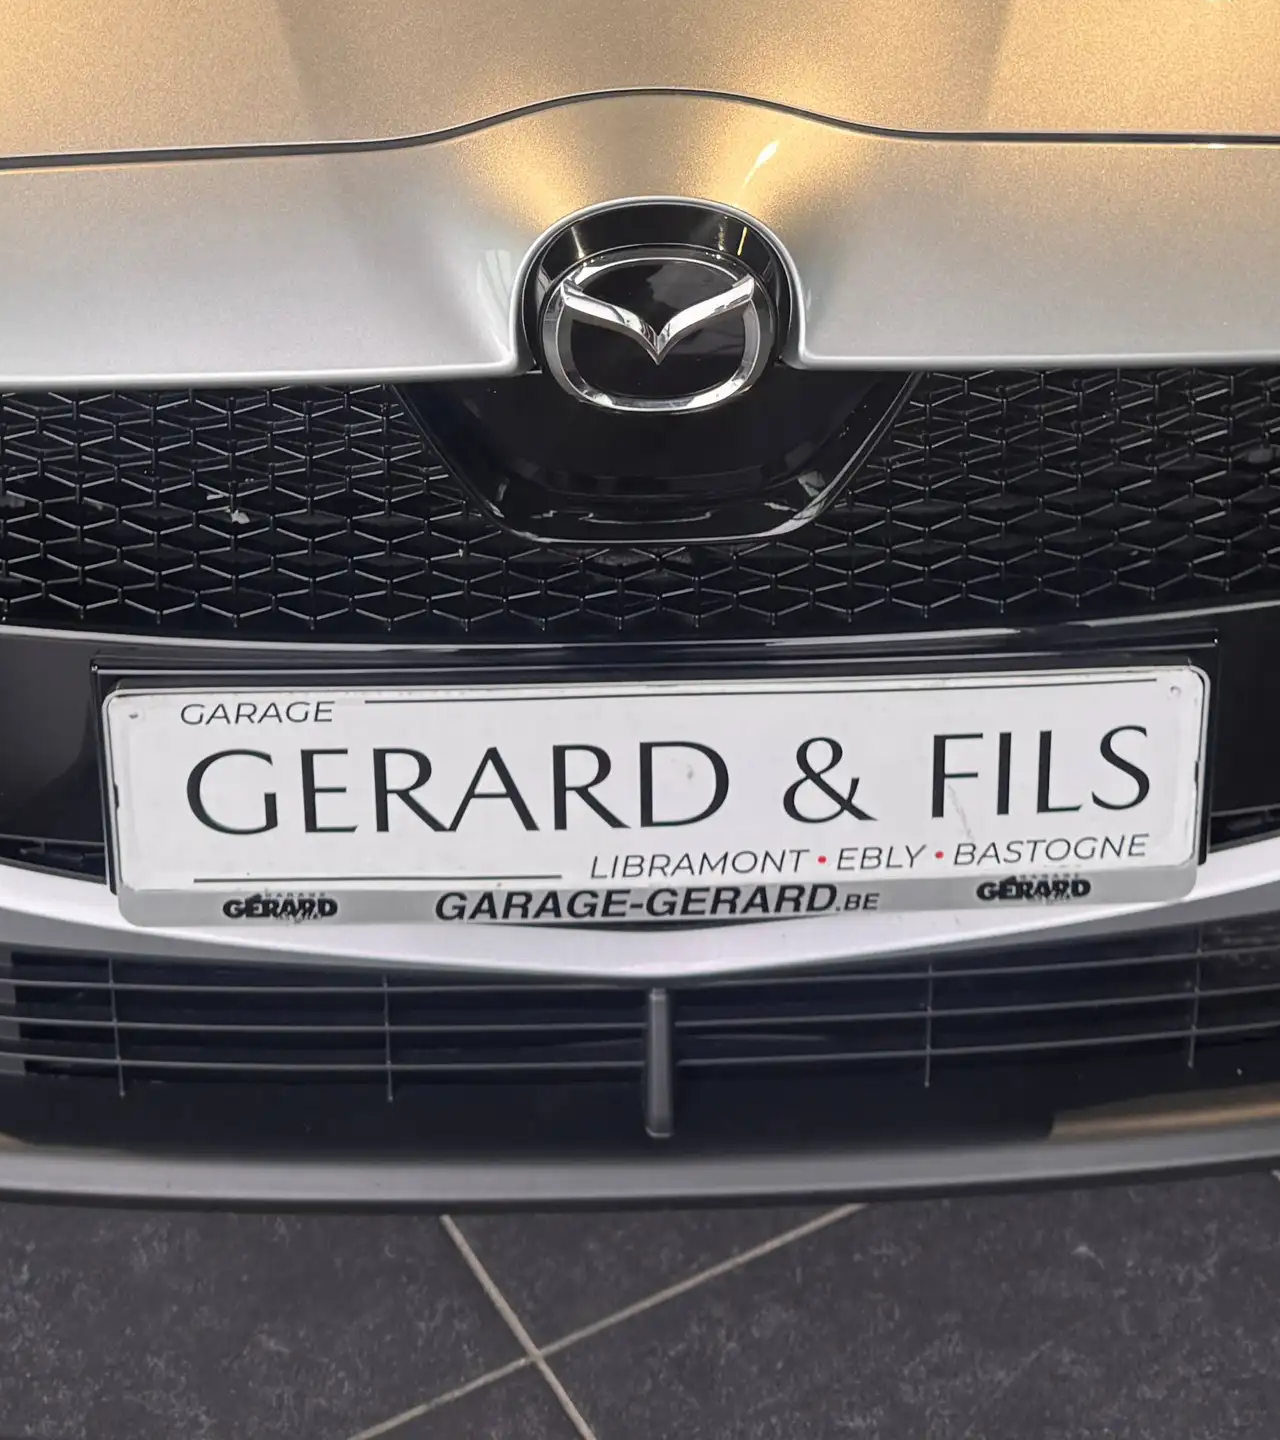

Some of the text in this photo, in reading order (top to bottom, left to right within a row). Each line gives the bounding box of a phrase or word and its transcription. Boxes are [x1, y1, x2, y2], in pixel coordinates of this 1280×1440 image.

[180, 700, 336, 726] GARAGE
[186, 724, 1151, 836] GERARD & FILS
[589, 832, 1151, 880] LIBRAMONT EBLY BASTOGNE
[434, 883, 880, 921] GARAGE-GERARD.BE
